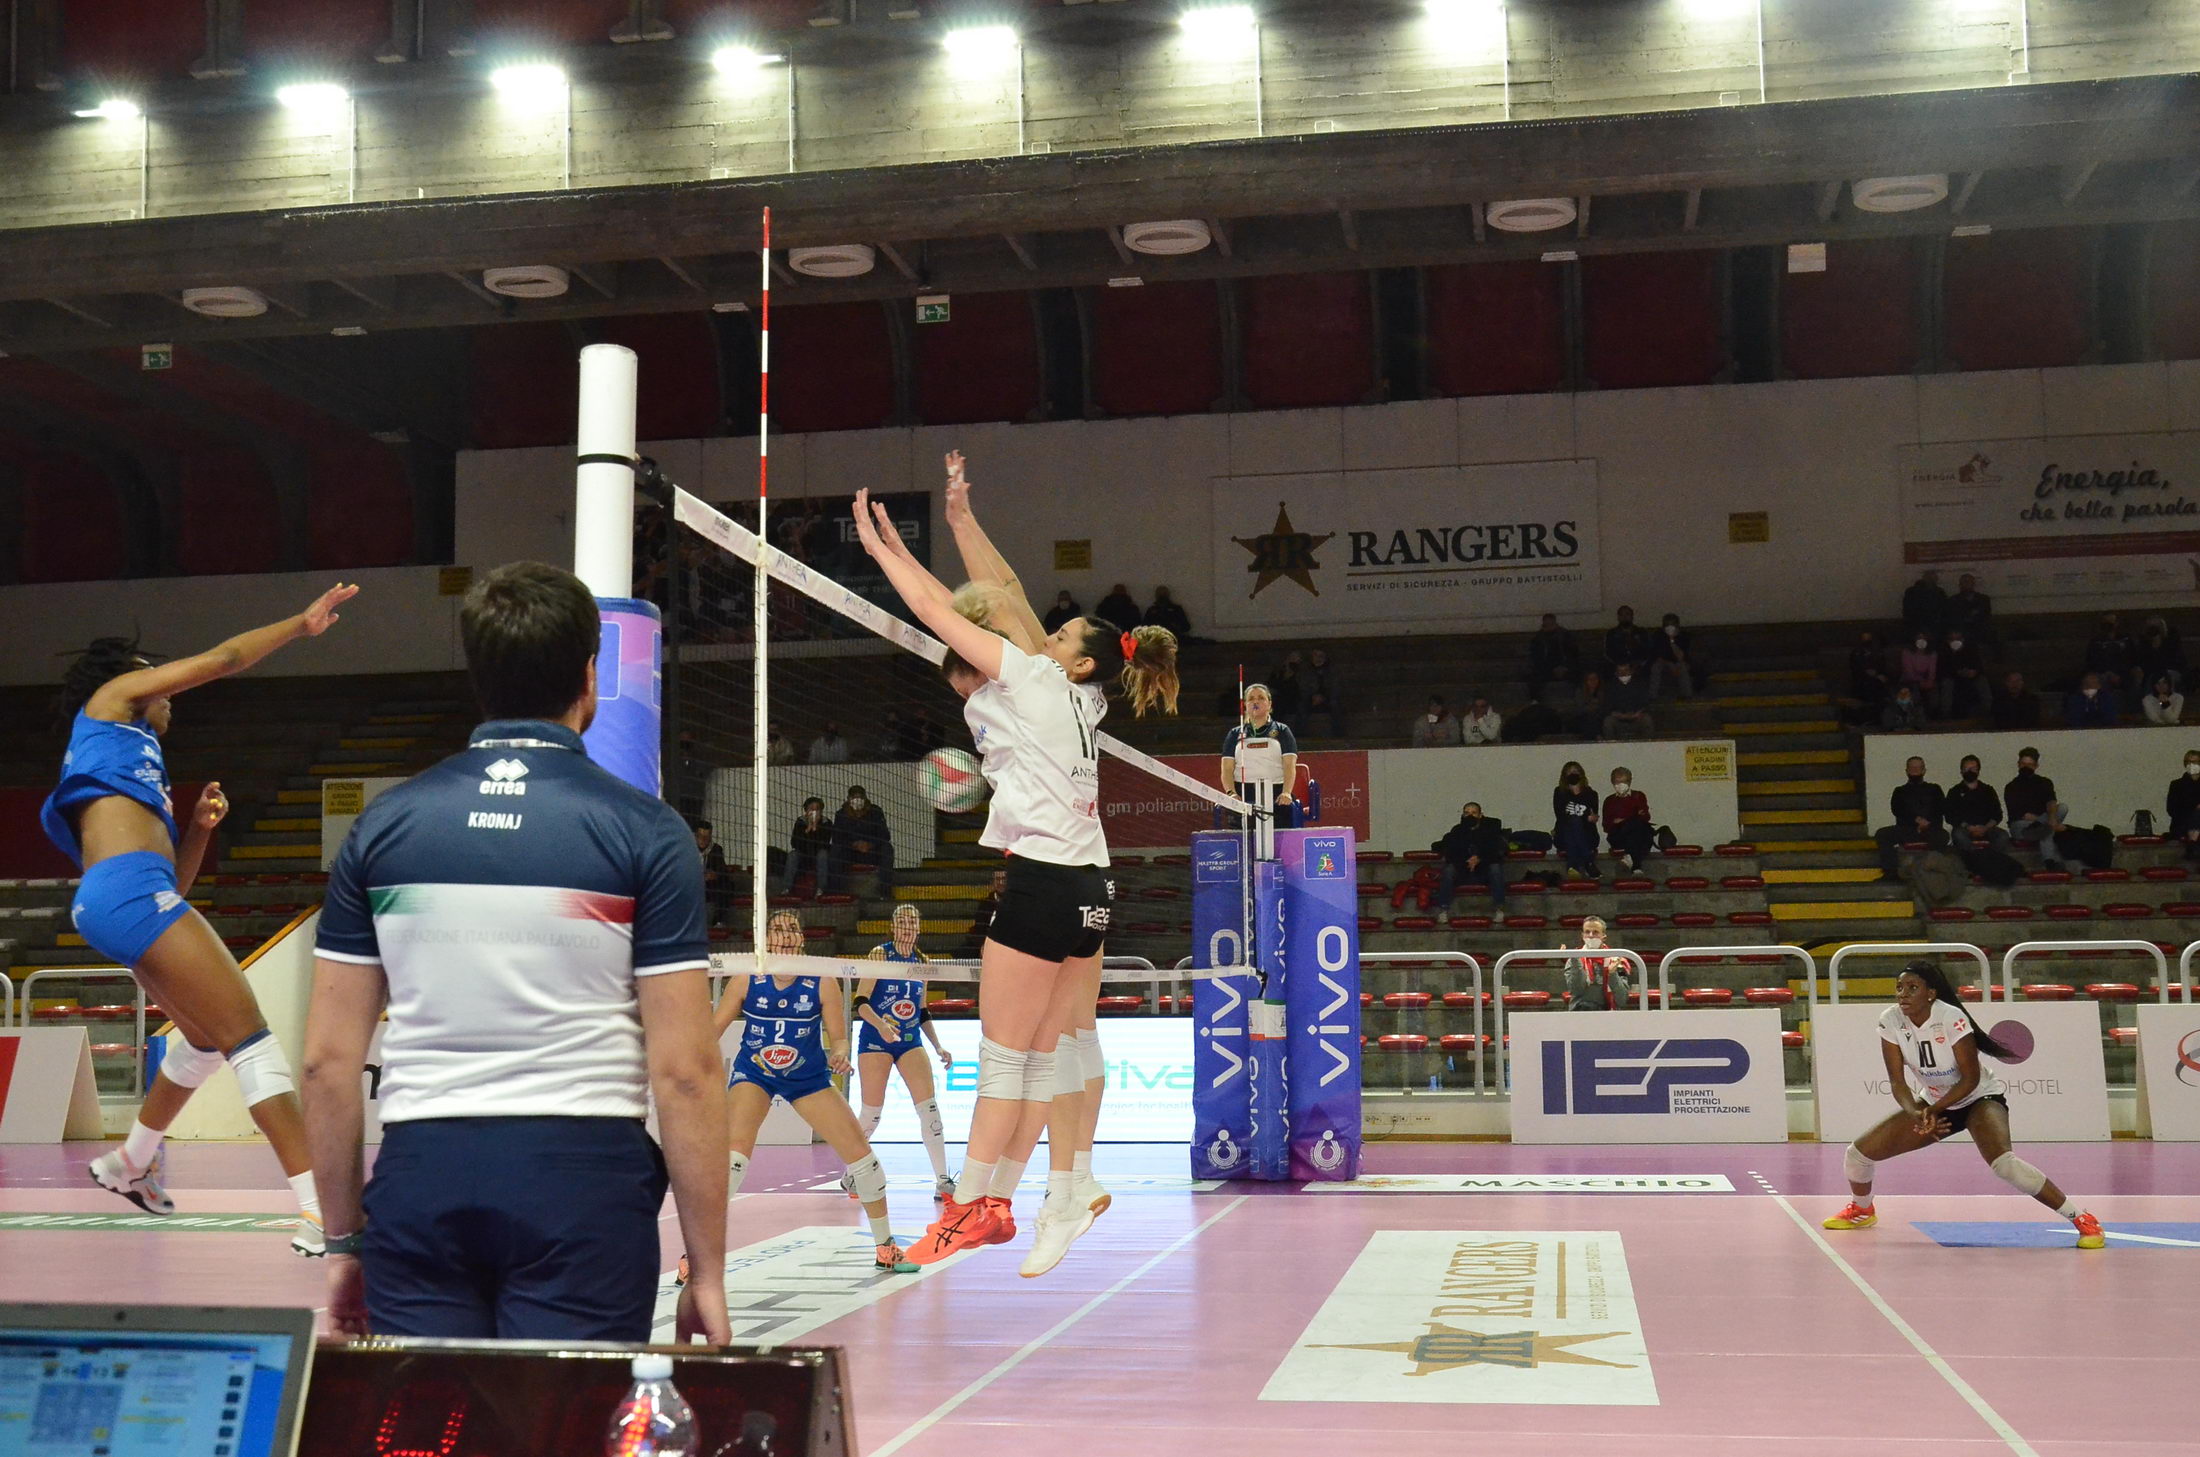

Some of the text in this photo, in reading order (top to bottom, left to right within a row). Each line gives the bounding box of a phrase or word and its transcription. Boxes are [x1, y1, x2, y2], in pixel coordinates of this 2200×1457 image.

[2034, 462, 2169, 498] Energia,
[2020, 503, 2055, 521] che
[2064, 500, 2113, 518] bella
[1348, 521, 1580, 566] RANGERS
[1347, 582, 1386, 591] SERVIZI
[1389, 581, 1399, 589] DI
[1403, 577, 1460, 588] SICUREZZA
[1471, 575, 1513, 586] GRUPPO
[1517, 573, 1583, 583] BATTISTOLLI
[1106, 802, 1131, 817] gm
[468, 811, 523, 830] KRONAJ
[386, 929, 599, 949] FEDERAZIONE ITALIANA PALLAVOLO
[903, 981, 911, 999] 1
[1306, 925, 1350, 1088] vivo
[774, 1020, 786, 1044] 2
[1917, 1040, 1937, 1068] 10
[1541, 1038, 1750, 1114] IEP
[1673, 1089, 1714, 1097] IMPIANTI
[1674, 1106, 1751, 1114] PROGETTAZIONE
[1460, 1180, 1711, 1188] MASCHIO
[1430, 1241, 1540, 1319] RANGERS
